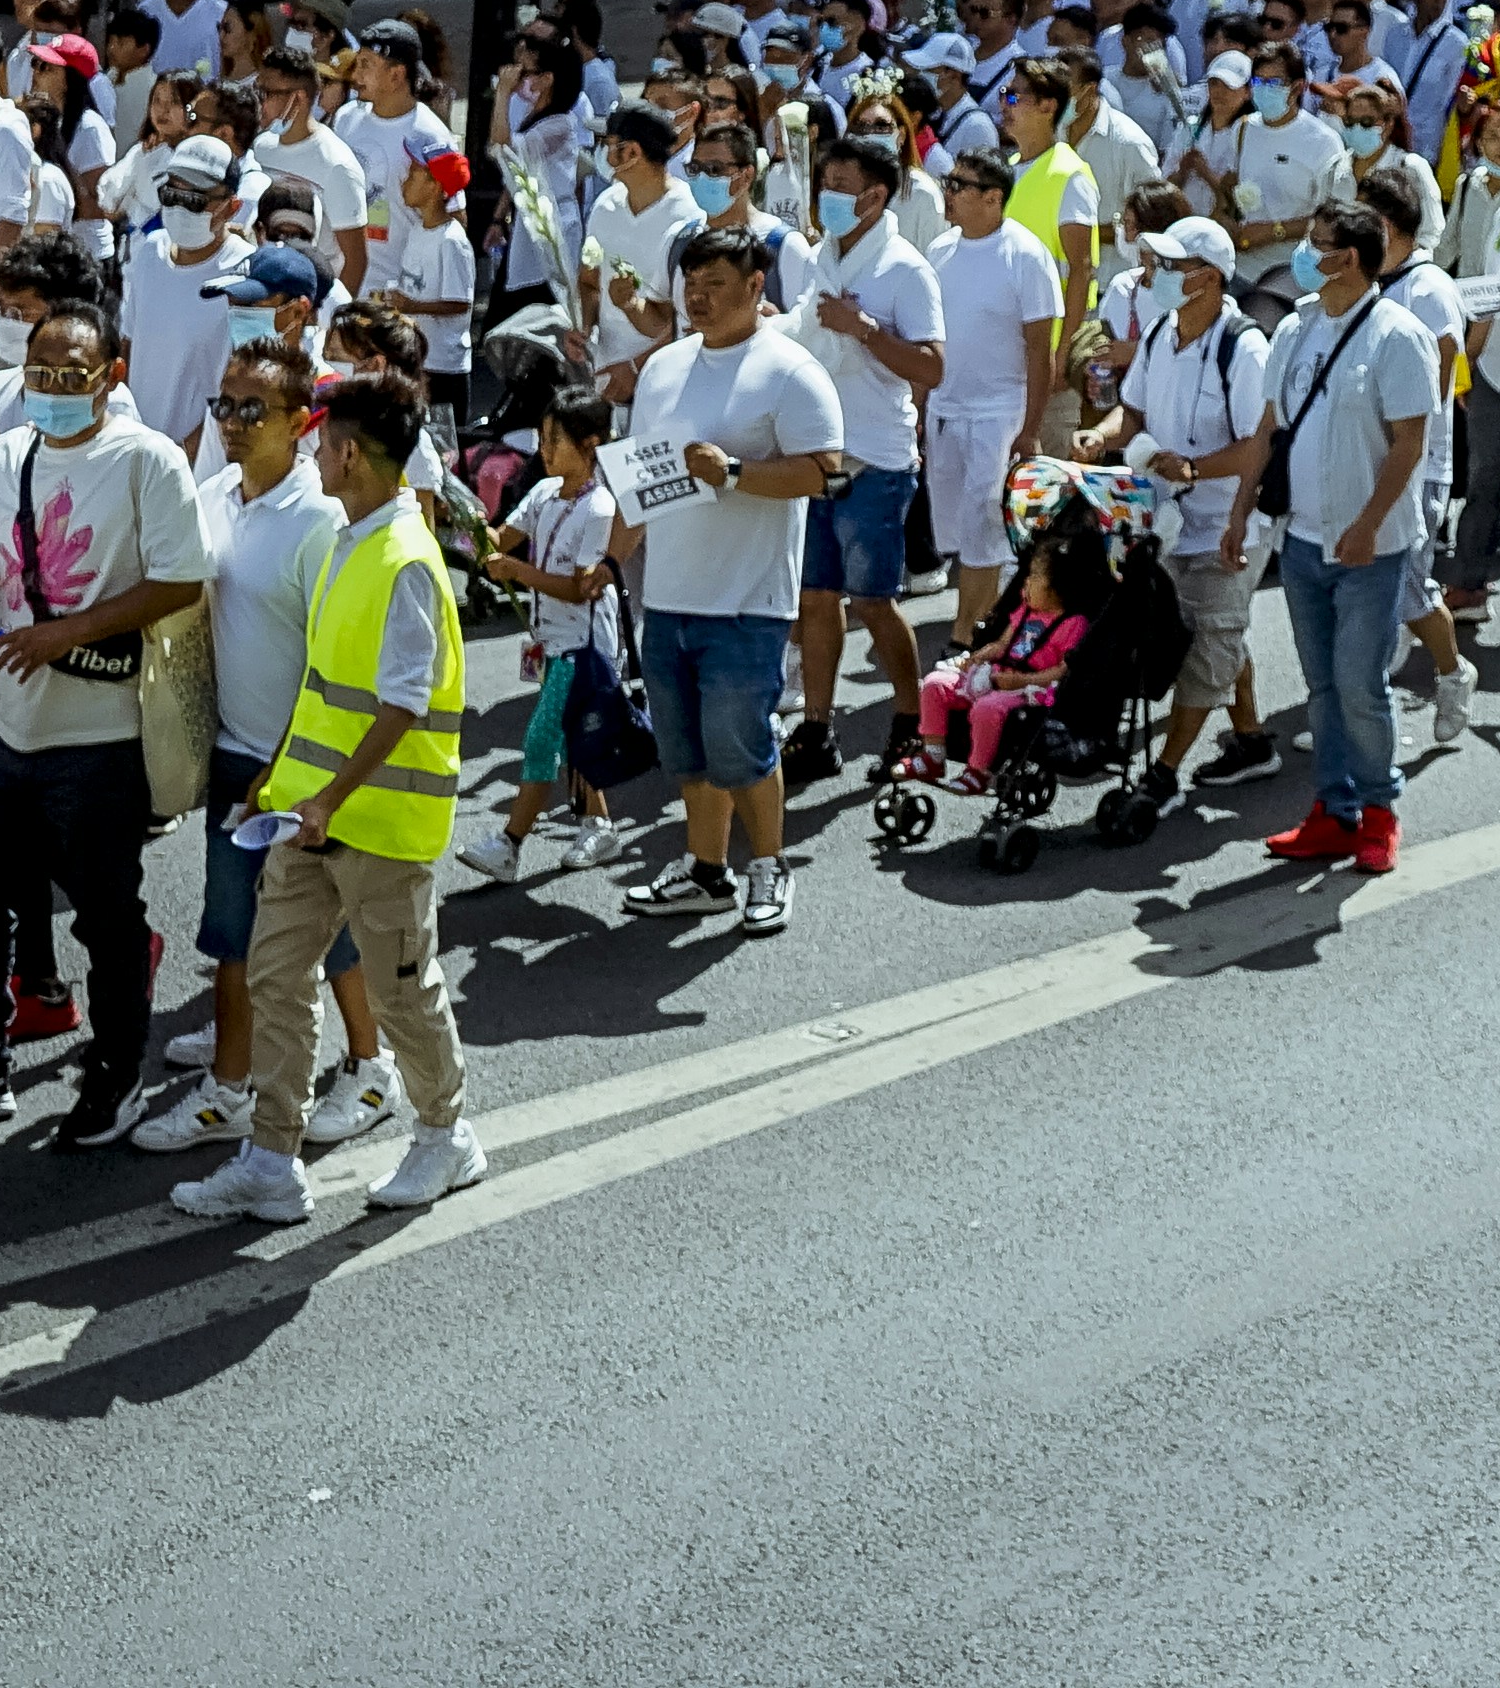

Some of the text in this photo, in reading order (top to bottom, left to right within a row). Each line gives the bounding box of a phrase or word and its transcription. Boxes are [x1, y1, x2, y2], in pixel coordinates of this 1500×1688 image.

[624, 439, 675, 466] ASSEZ
[636, 458, 679, 485] C'EST
[643, 478, 695, 507] ASSEZ
[69, 645, 133, 673] Tibet
